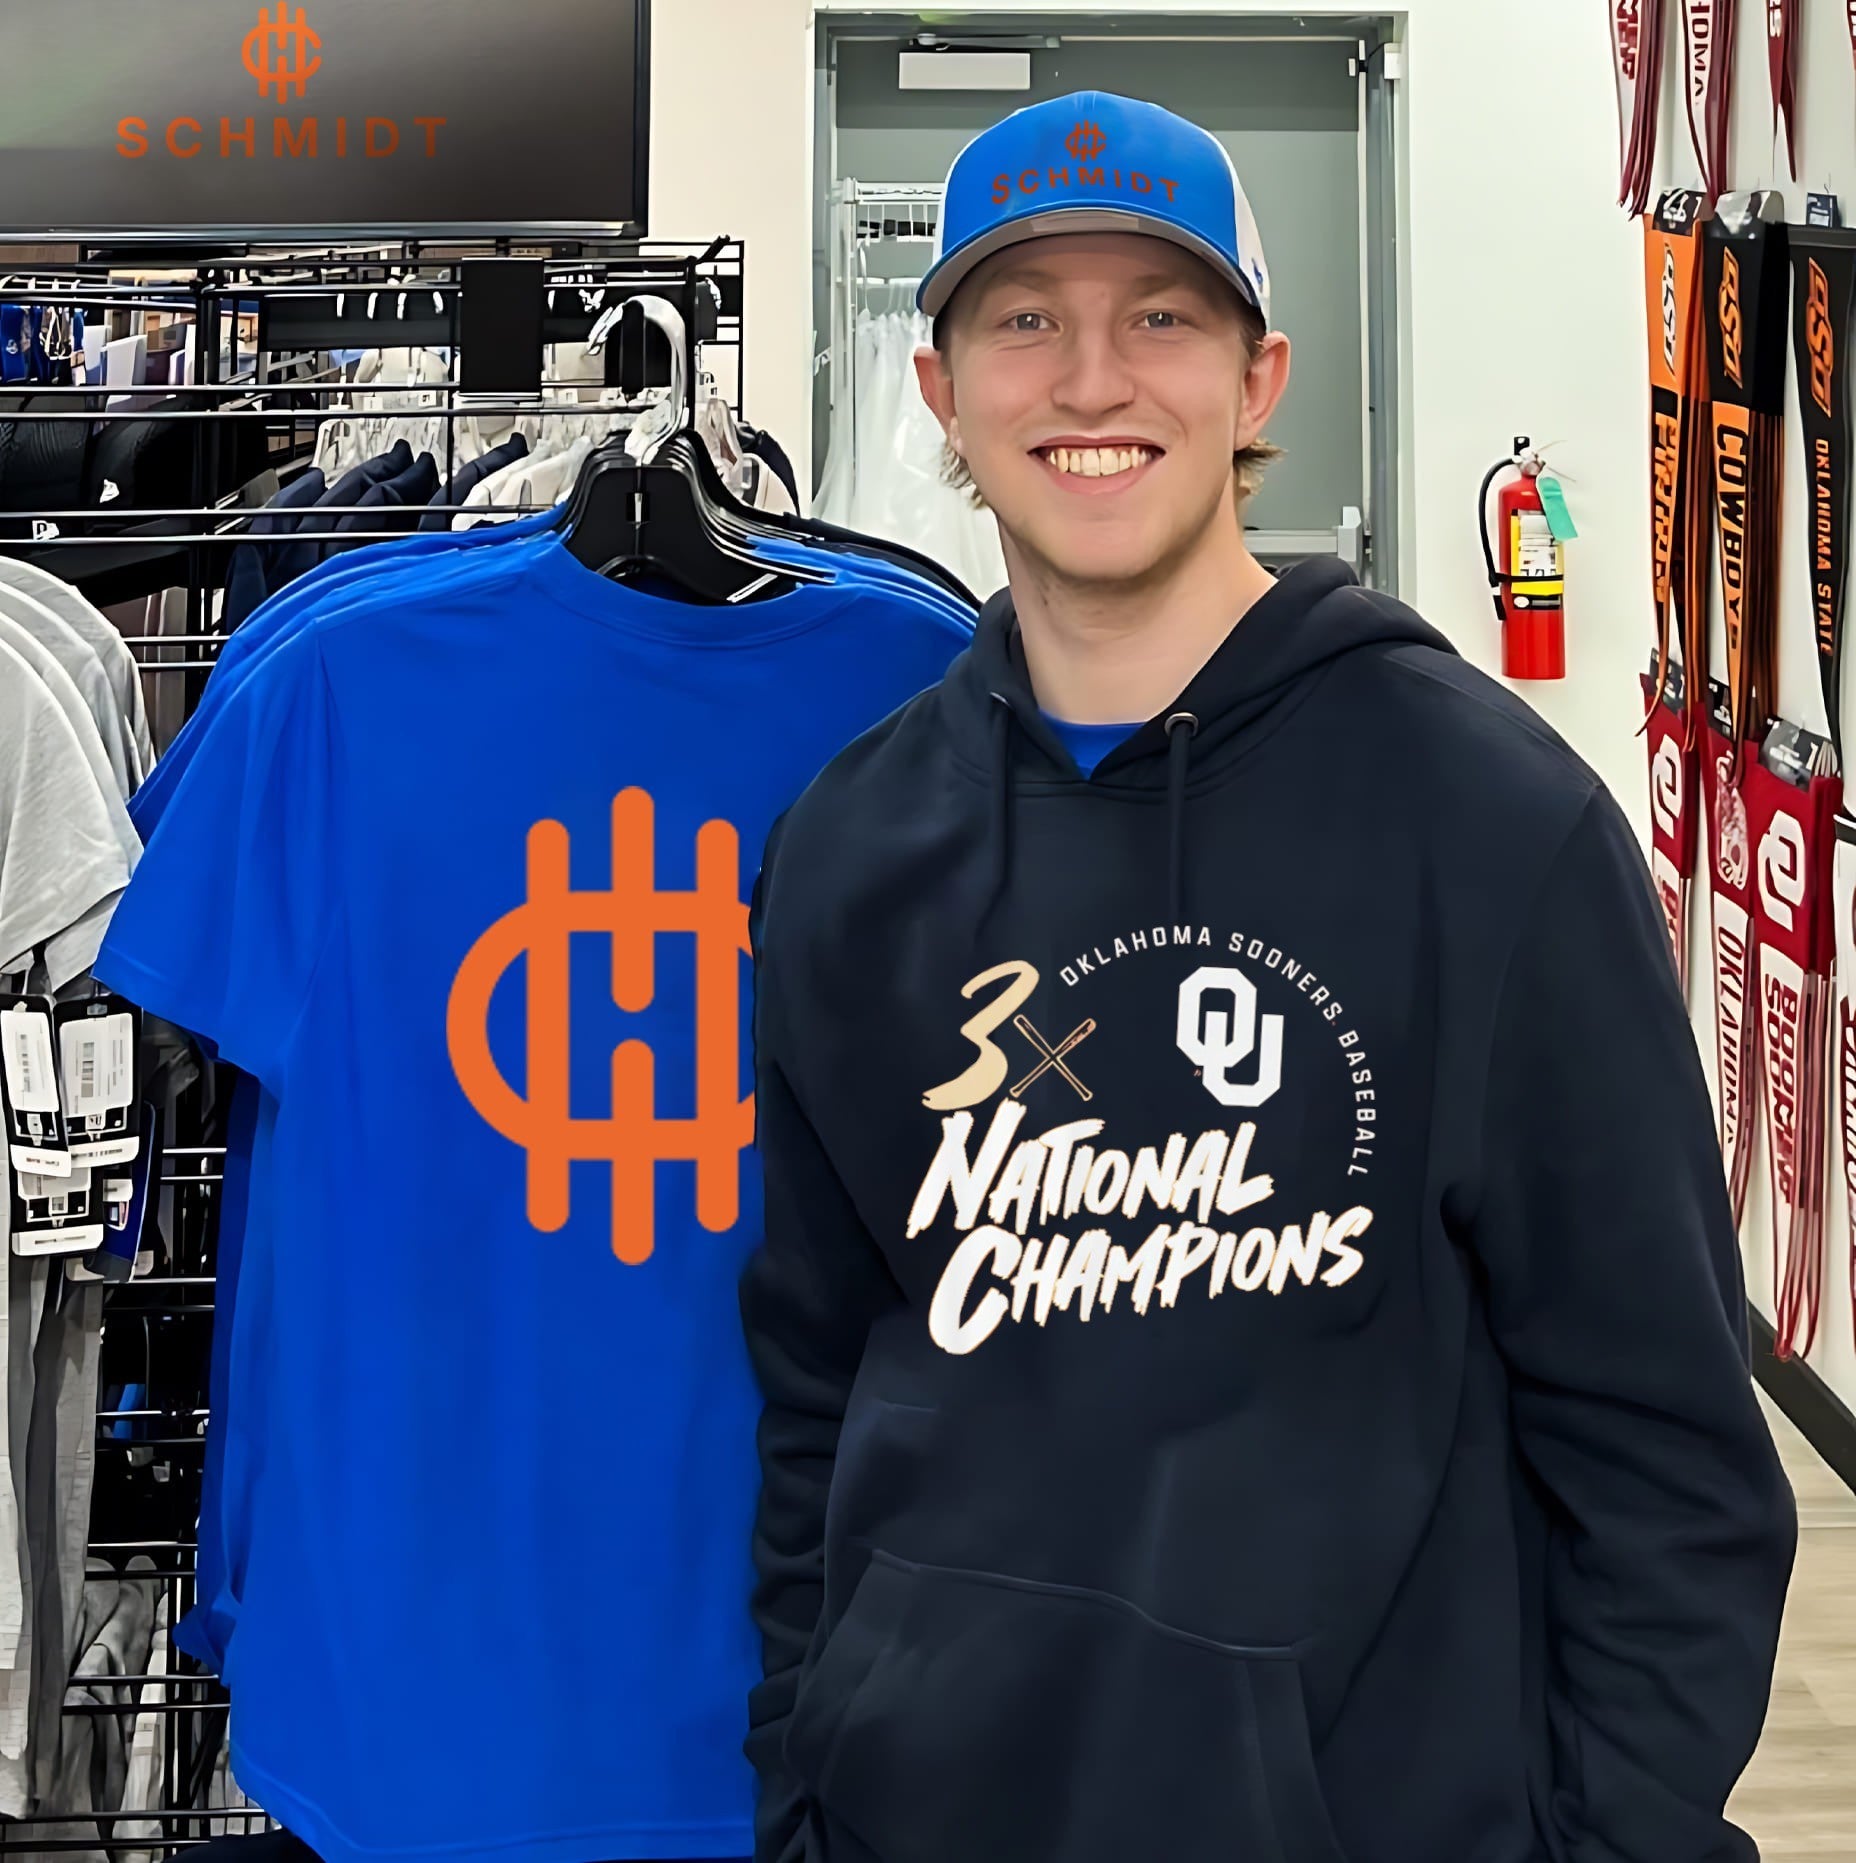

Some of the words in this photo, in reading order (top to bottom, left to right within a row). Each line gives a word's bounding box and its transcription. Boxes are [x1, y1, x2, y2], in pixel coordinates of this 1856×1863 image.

[115, 116, 447, 159] SCHMIDT
[991, 166, 1179, 204] SCHMIDT
[1816, 438, 1832, 571] OKLAHOMA
[1817, 582, 1833, 657] STATE
[1059, 925, 1212, 987] OKLAHOMA
[1228, 932, 1344, 1023] SOONERS
[1338, 1029, 1377, 1176] BASEBALL
[1176, 966, 1285, 1108] OU
[1718, 926, 1745, 1143] OKLAHOMA
[906, 1097, 1275, 1240] NATIONAL
[928, 1205, 1374, 1356] CHAMPIONS
